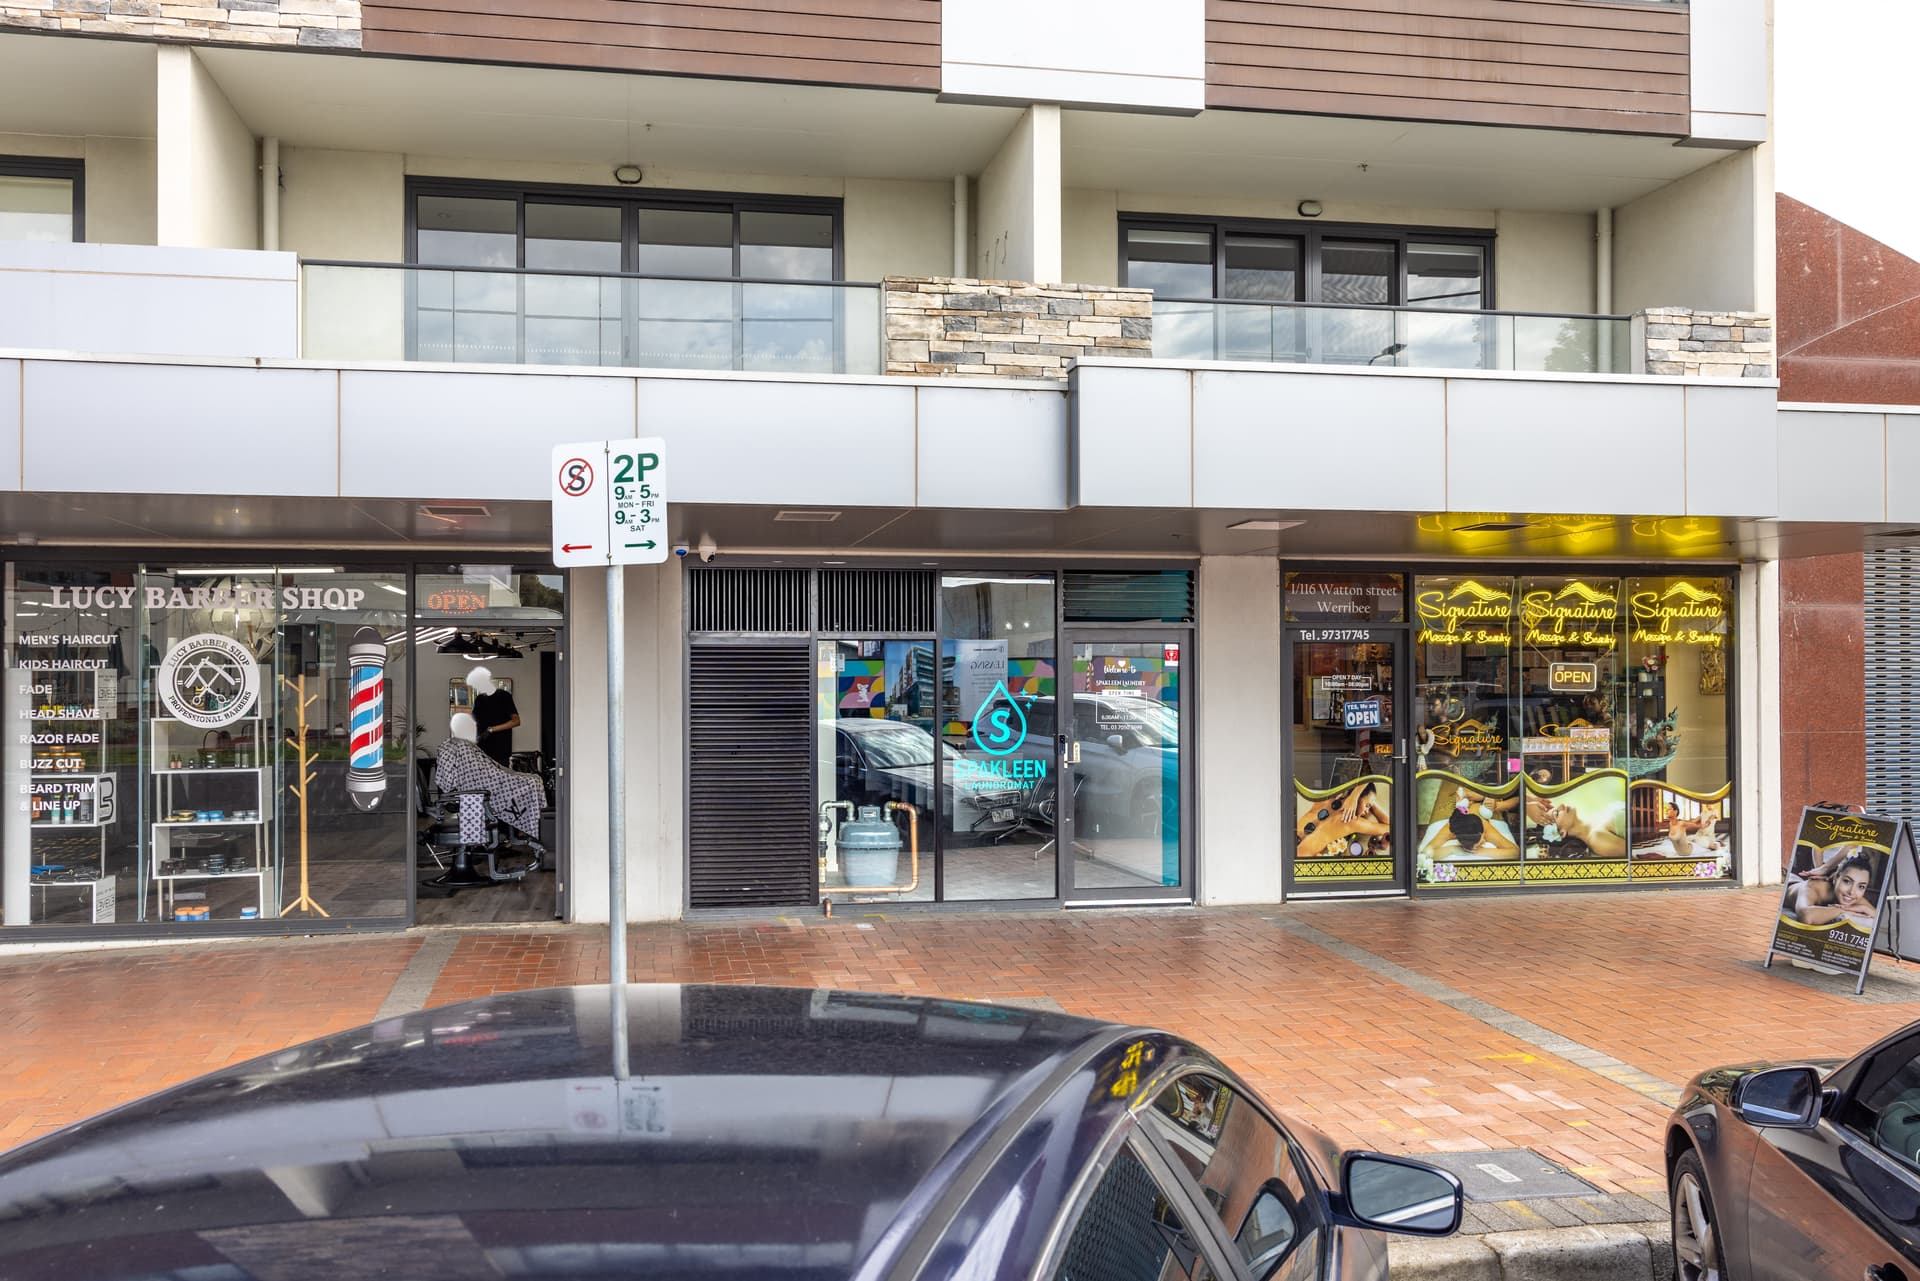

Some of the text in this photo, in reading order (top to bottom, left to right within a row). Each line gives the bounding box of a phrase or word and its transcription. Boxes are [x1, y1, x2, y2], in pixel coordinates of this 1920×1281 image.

[613, 453, 659, 483] 2P
[50, 586, 365, 610] LUCY BARBER SHOP
[1319, 584, 1363, 596] Watton
[1366, 587, 1398, 596] street
[428, 594, 486, 610] OPEN
[1316, 602, 1371, 614] Werribee
[1416, 592, 1511, 633] Signature
[1524, 592, 1616, 633] Signature
[1631, 592, 1721, 633] Signature
[20, 634, 118, 645] MEN'S HAIRCUT
[1418, 630, 1512, 647] Massage & Beauty
[1526, 629, 1616, 649] Massage & Beauty
[1632, 629, 1722, 648] Massage & Beauty
[168, 638, 250, 668] LUCY BARBER SHOP
[20, 660, 108, 670] KIDS HAIRCUT
[1554, 671, 1591, 683] OPEN
[20, 685, 52, 694] FADE
[20, 709, 100, 719] HEAD SHAVE
[168, 690, 252, 724] PROFESSIONAL BARBERS
[989, 709, 1011, 743] S
[1347, 711, 1378, 726] OPEN
[20, 734, 100, 744] RAZOR FADE
[1431, 724, 1503, 757] Signature
[20, 758, 81, 769] BUZZ CUT
[953, 760, 1047, 778] SPAKLEEN
[20, 784, 96, 794] BEARD TRIM
[964, 780, 1034, 790] LAUNDROMAT
[32, 801, 60, 810] LINE
[64, 800, 80, 810] UP
[1815, 815, 1878, 840] Signature
[1828, 930, 1848, 942] 9731
[1850, 934, 1870, 946] 7745
